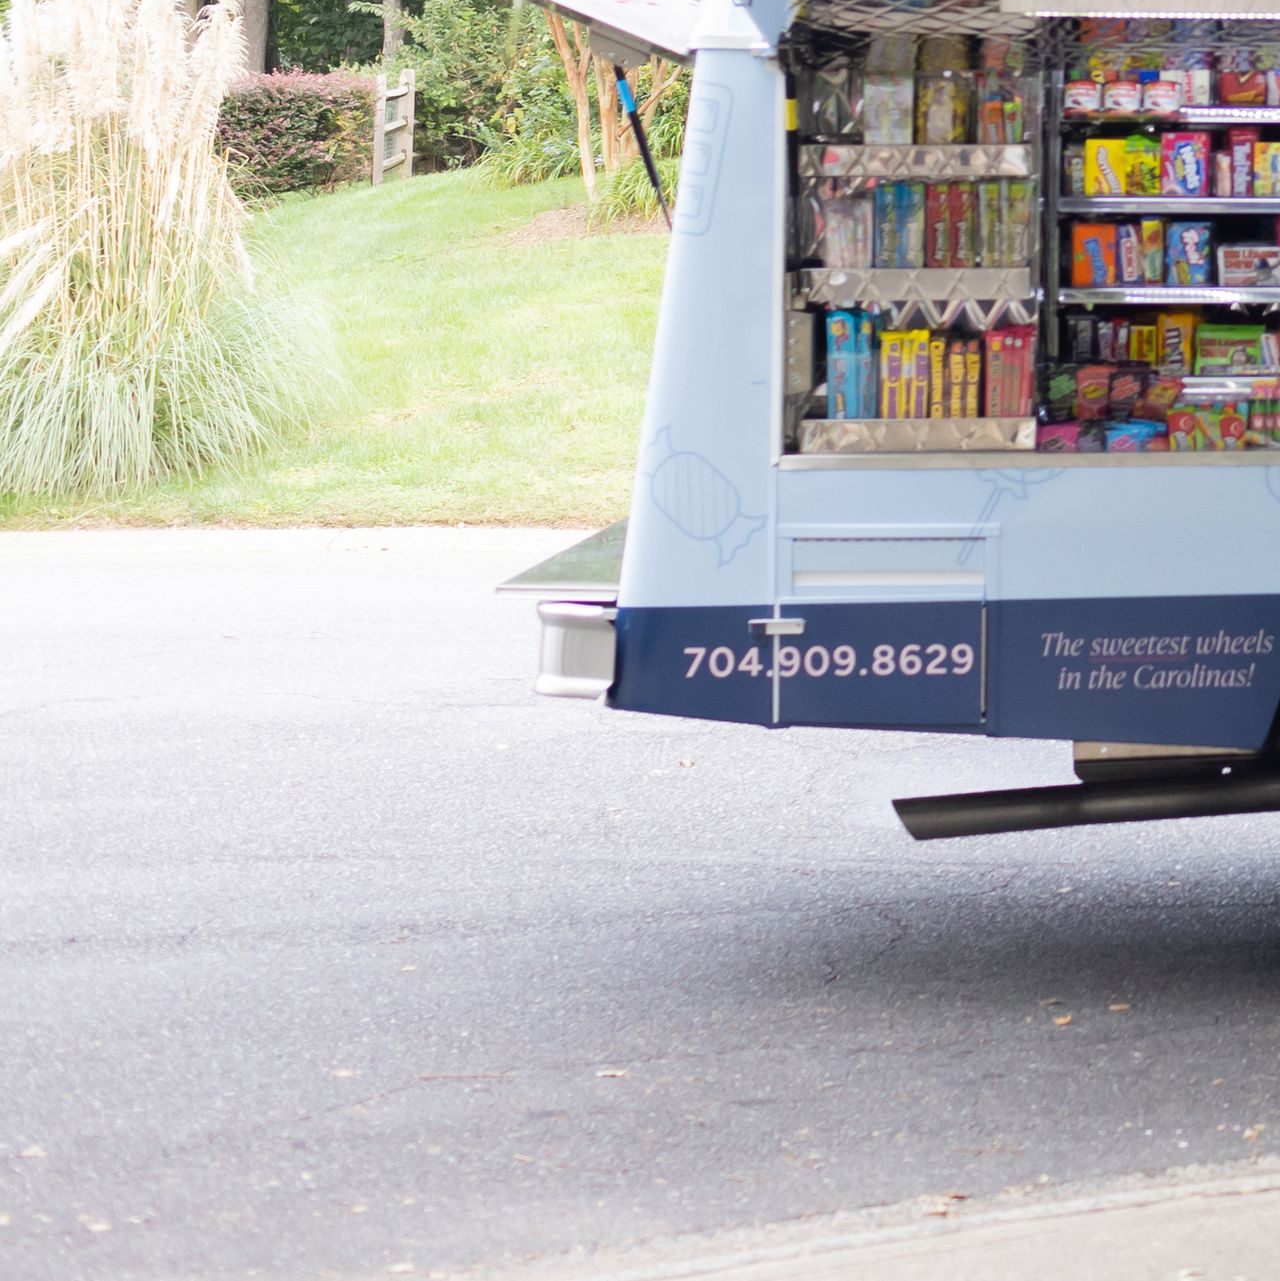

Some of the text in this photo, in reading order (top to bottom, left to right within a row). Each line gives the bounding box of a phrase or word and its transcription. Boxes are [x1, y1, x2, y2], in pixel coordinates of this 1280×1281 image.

[1042, 629, 1275, 658] The sweetest wheels
[683, 643, 975, 678] 704.909.8629
[1057, 662, 1256, 690] in the Carolinas!
